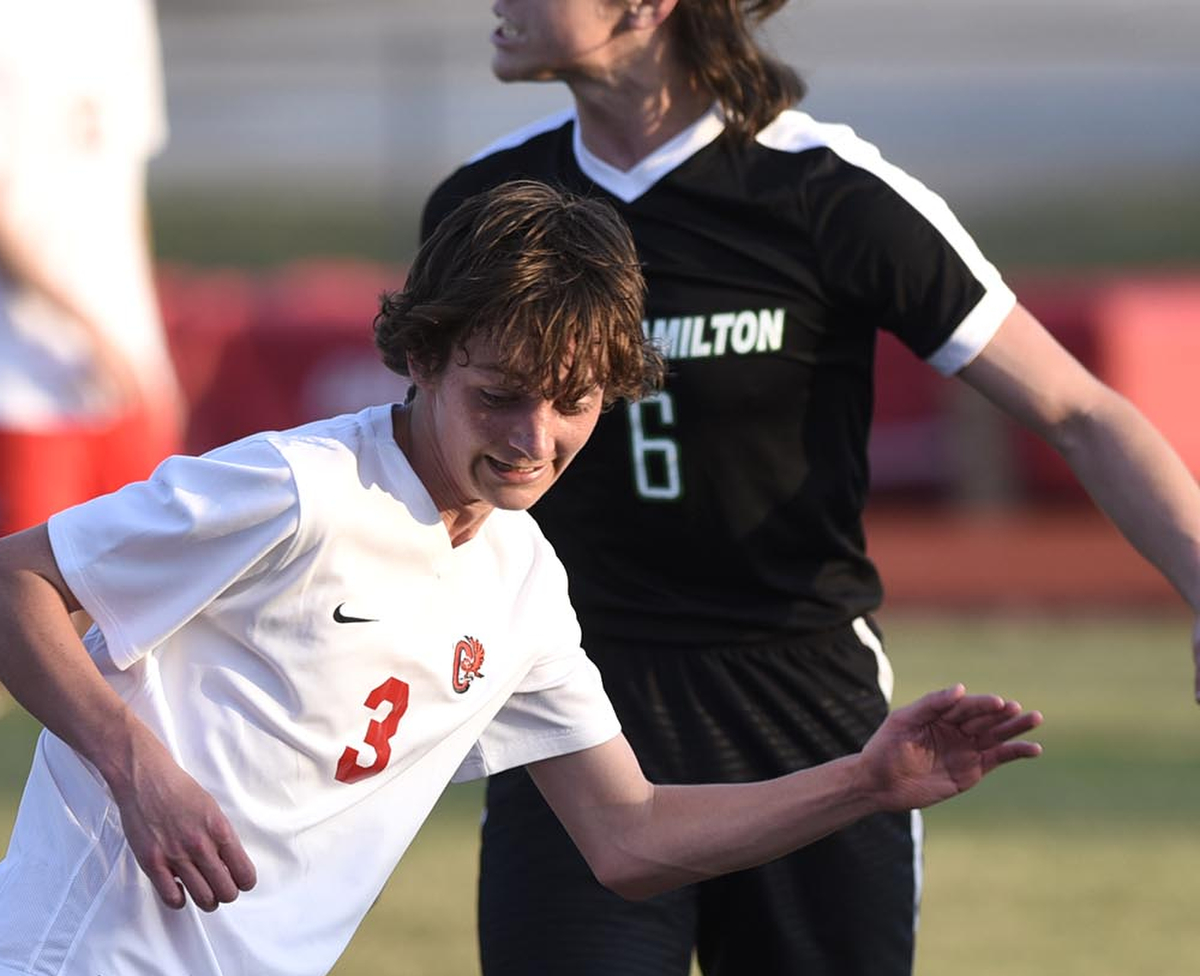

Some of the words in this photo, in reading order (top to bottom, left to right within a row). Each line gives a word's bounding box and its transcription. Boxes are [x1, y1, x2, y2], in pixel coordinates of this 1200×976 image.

[641, 308, 785, 358] MILTON
[629, 391, 681, 500] 6
[334, 676, 409, 785] 3
